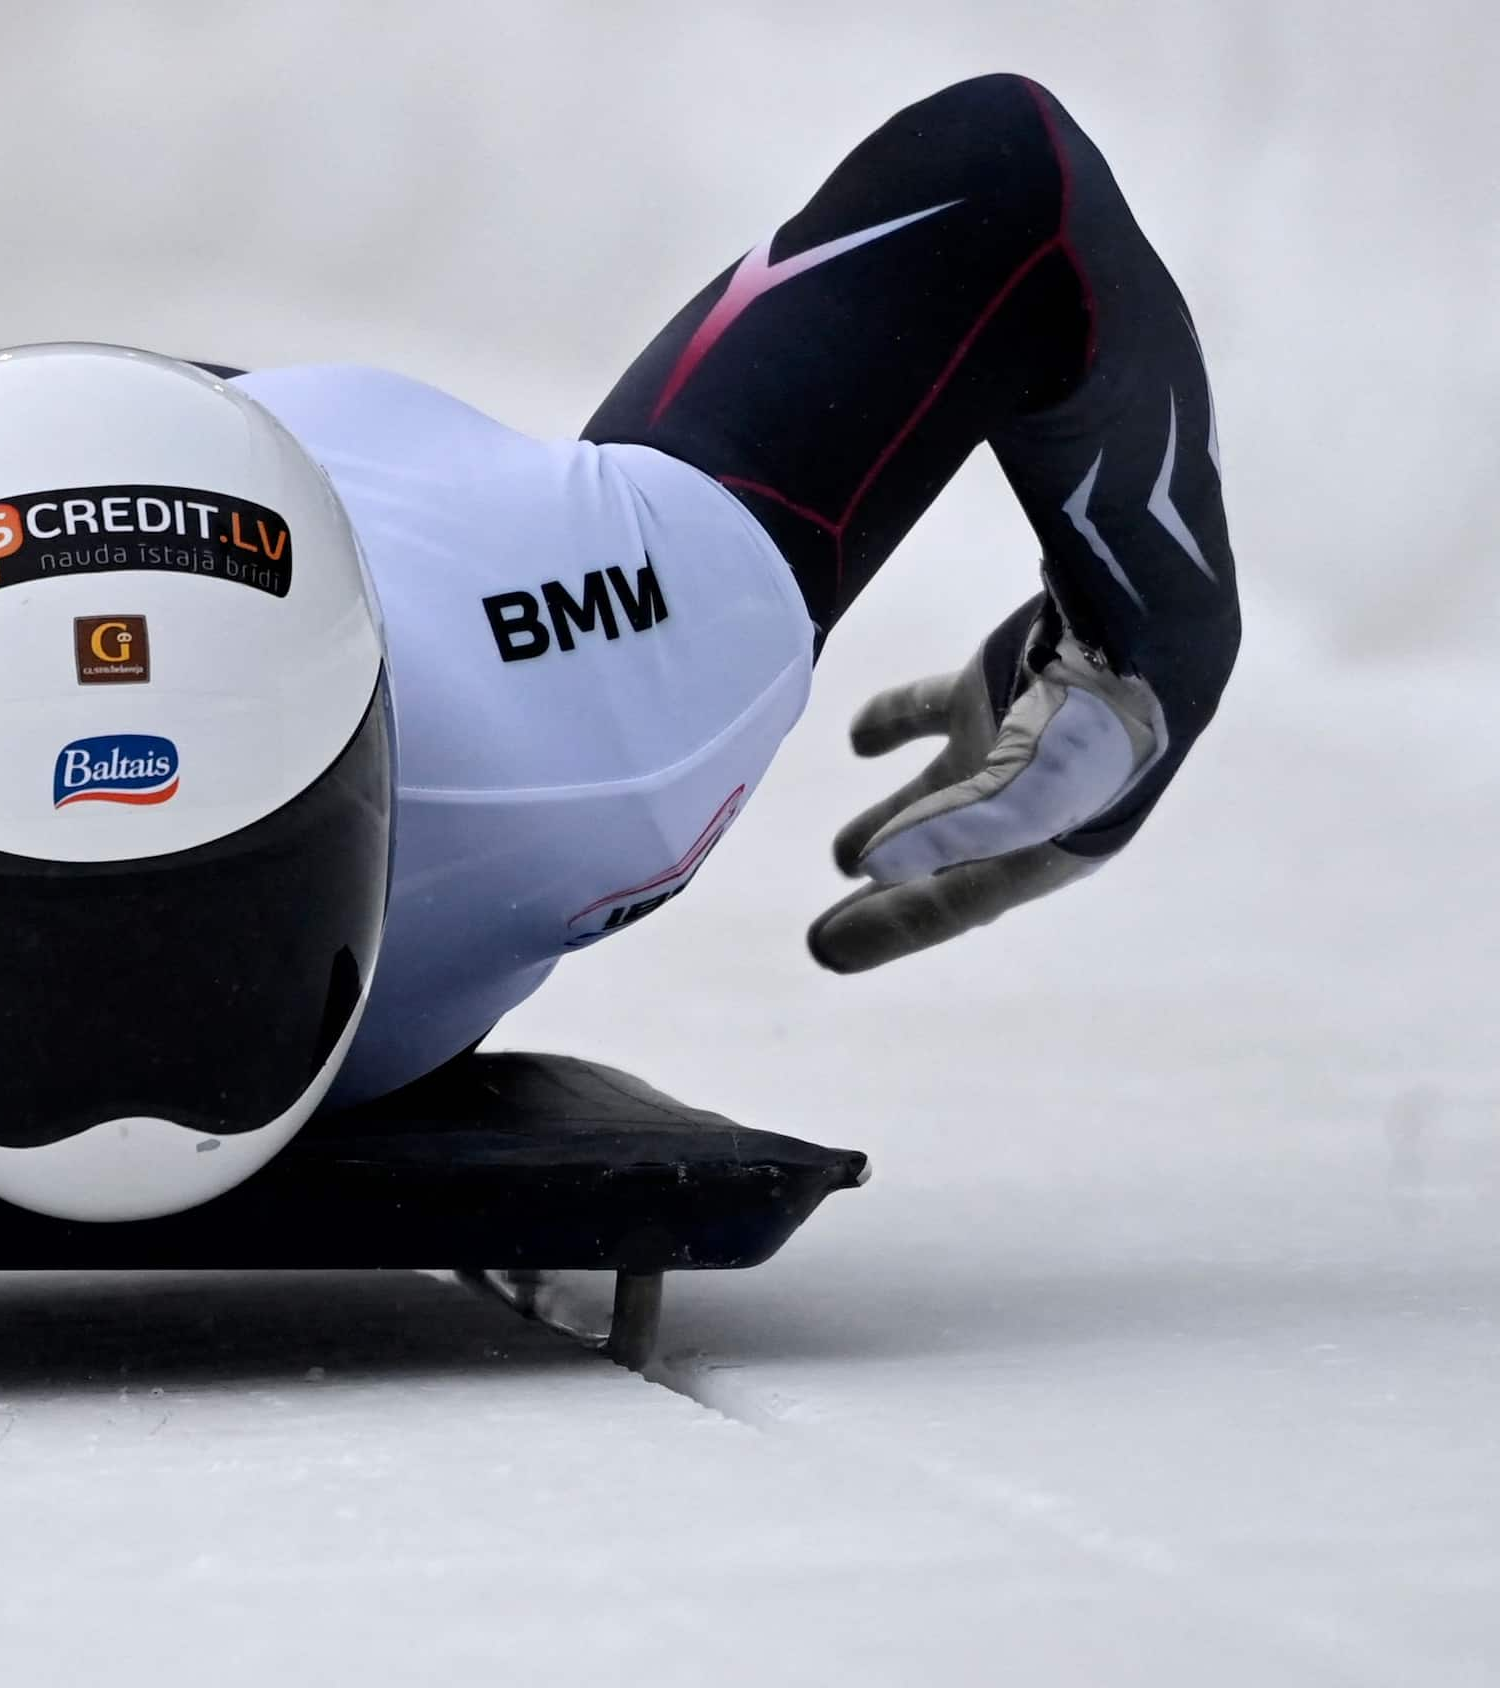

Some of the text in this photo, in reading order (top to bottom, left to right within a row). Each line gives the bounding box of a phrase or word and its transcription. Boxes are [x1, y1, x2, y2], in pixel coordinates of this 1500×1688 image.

[41, 542, 281, 592] nauda īstajā brīdī
[481, 552, 669, 663] BMW
[63, 748, 171, 788] Baltais
